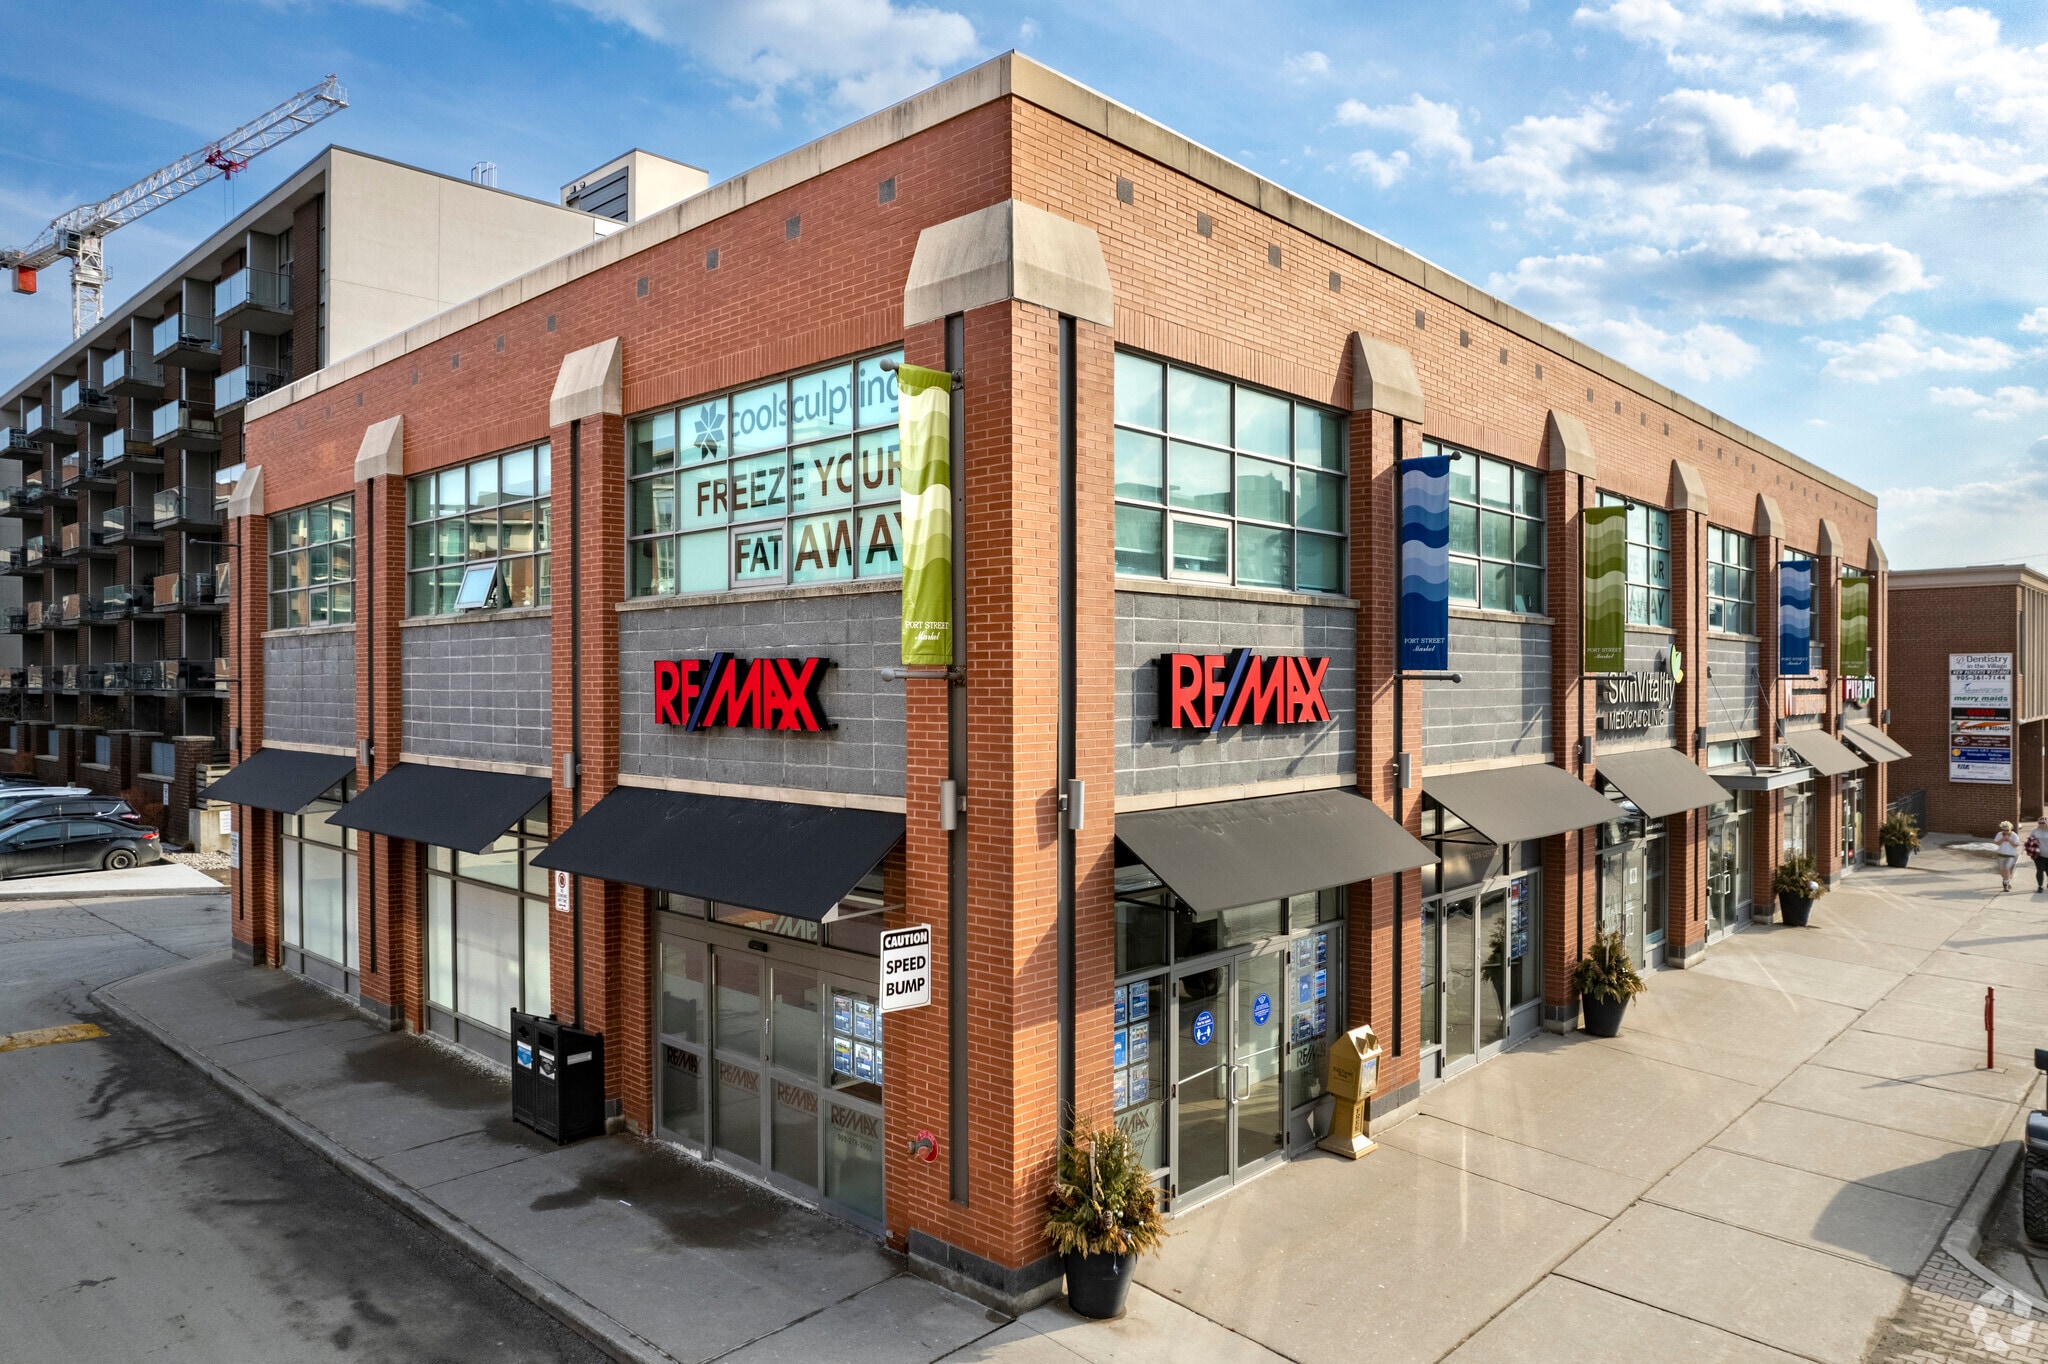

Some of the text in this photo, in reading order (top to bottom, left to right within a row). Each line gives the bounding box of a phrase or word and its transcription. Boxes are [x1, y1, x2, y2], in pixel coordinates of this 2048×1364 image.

[697, 462, 805, 517] FREEZE
[737, 534, 783, 574] FAT
[905, 620, 949, 630] PORT STREET
[914, 631, 941, 641] Market
[1966, 654, 2008, 664] Dentistry
[654, 652, 821, 733] RE/MAX
[1171, 647, 1332, 734] RE/MAX
[1608, 671, 1676, 709] SkinVitality
[1609, 709, 1665, 730] MEDICAL CLINIC
[884, 931, 928, 949] CAUTION
[886, 955, 926, 975] SPEED
[886, 977, 925, 997] BUMP
